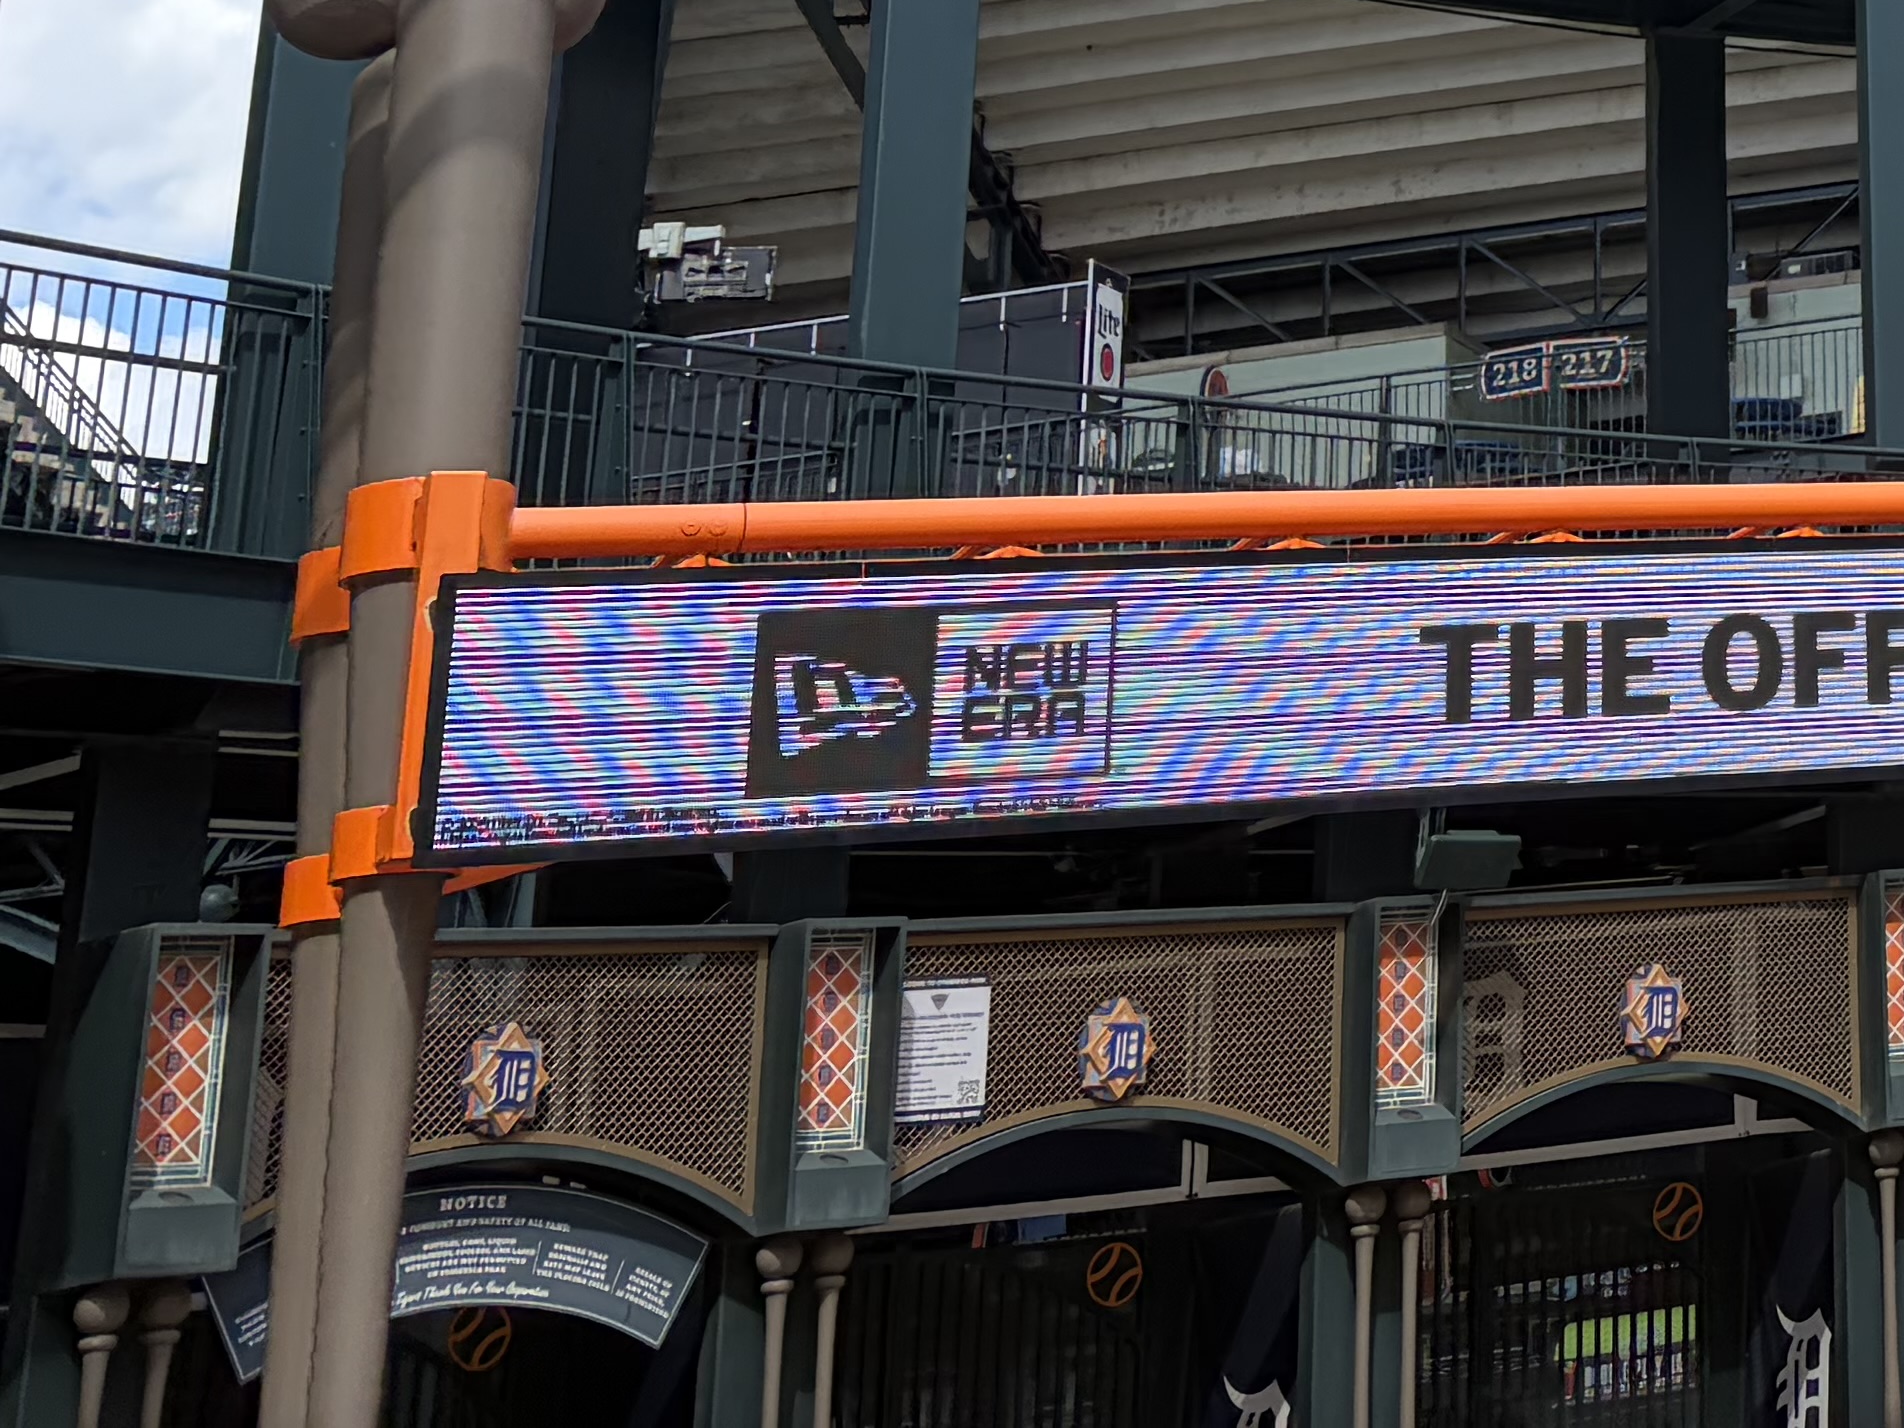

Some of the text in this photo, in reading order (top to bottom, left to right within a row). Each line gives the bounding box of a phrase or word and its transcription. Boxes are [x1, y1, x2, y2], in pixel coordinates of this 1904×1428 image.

[1097, 304, 1120, 339] Lite
[1492, 357, 1537, 387] 218
[1561, 350, 1613, 376] 217
[965, 640, 1089, 691] NEW
[1420, 616, 1672, 725] THE
[961, 695, 1087, 742] ERA
[439, 1195, 508, 1212] NOTICE
